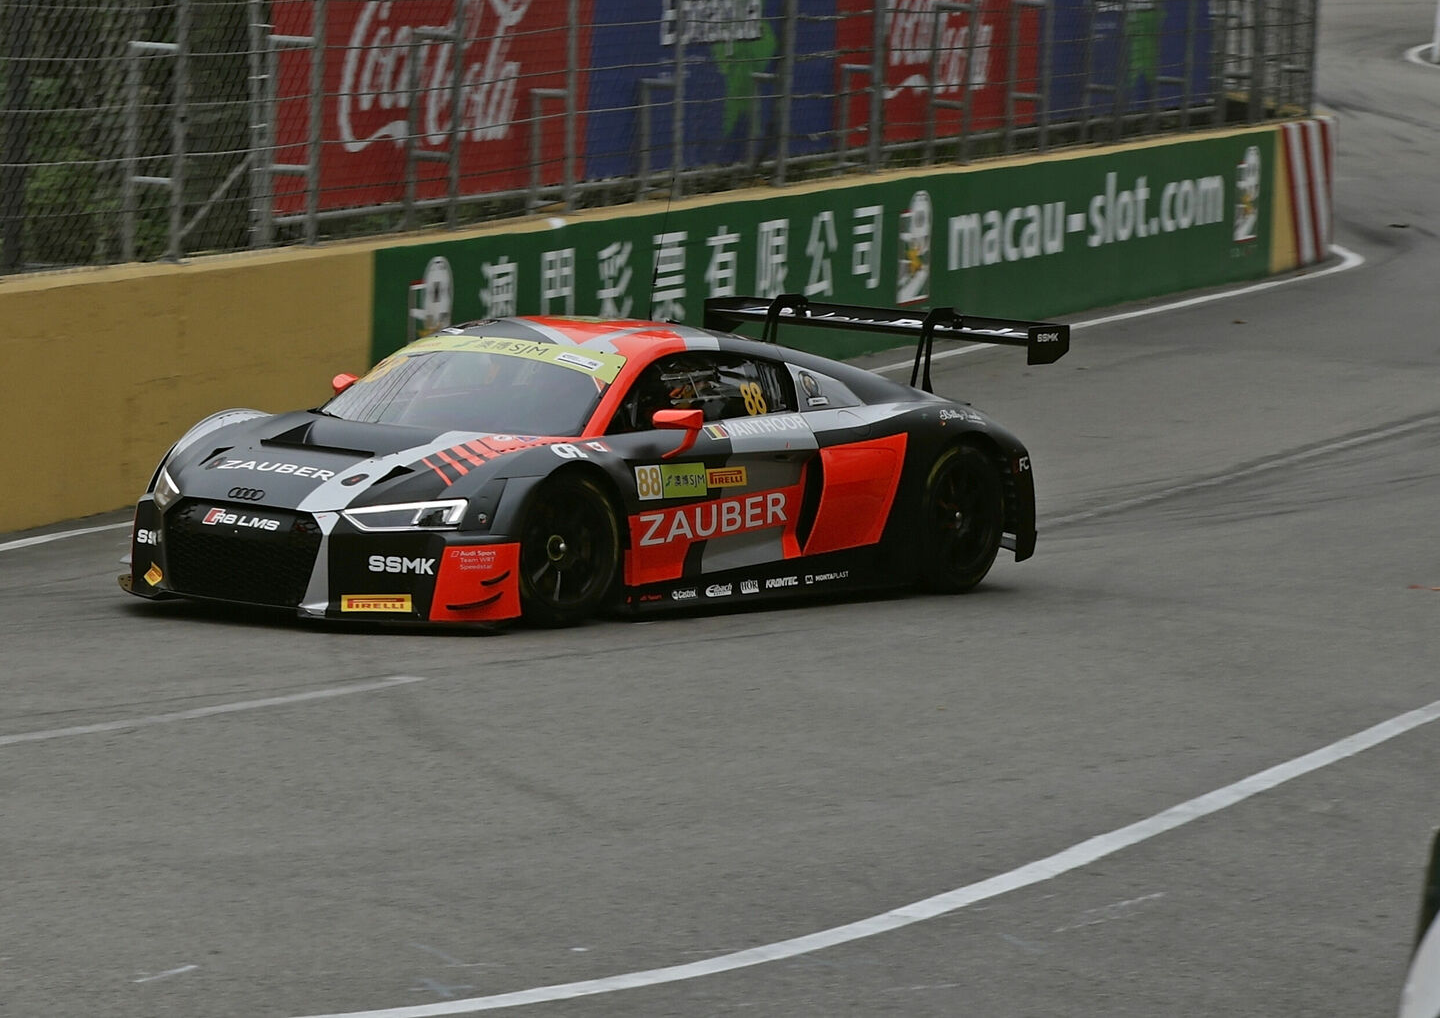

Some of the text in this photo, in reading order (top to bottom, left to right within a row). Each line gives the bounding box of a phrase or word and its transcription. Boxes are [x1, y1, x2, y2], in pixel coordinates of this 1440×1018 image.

[947, 171, 1224, 271] macau-slot.com
[480, 205, 884, 322] 澳門彩票有限公司
[1036, 332, 1060, 344] SSMK
[509, 343, 549, 357] SJM
[740, 381, 767, 416] 88
[721, 413, 811, 437] VANTHOOR
[217, 459, 335, 481] ZAUBER
[710, 470, 743, 485] PIRELLI
[637, 467, 661, 497] 88
[689, 474, 705, 488] SJM
[236, 514, 281, 531] LMS
[639, 492, 787, 547] ZAUBER
[477, 550, 497, 559] Sport
[368, 555, 436, 575] SSMK
[765, 575, 798, 589] KRONTEC
[815, 570, 849, 582] MONTAPLAST
[677, 589, 696, 599] Castrol
[347, 597, 406, 610] PIRELLI
